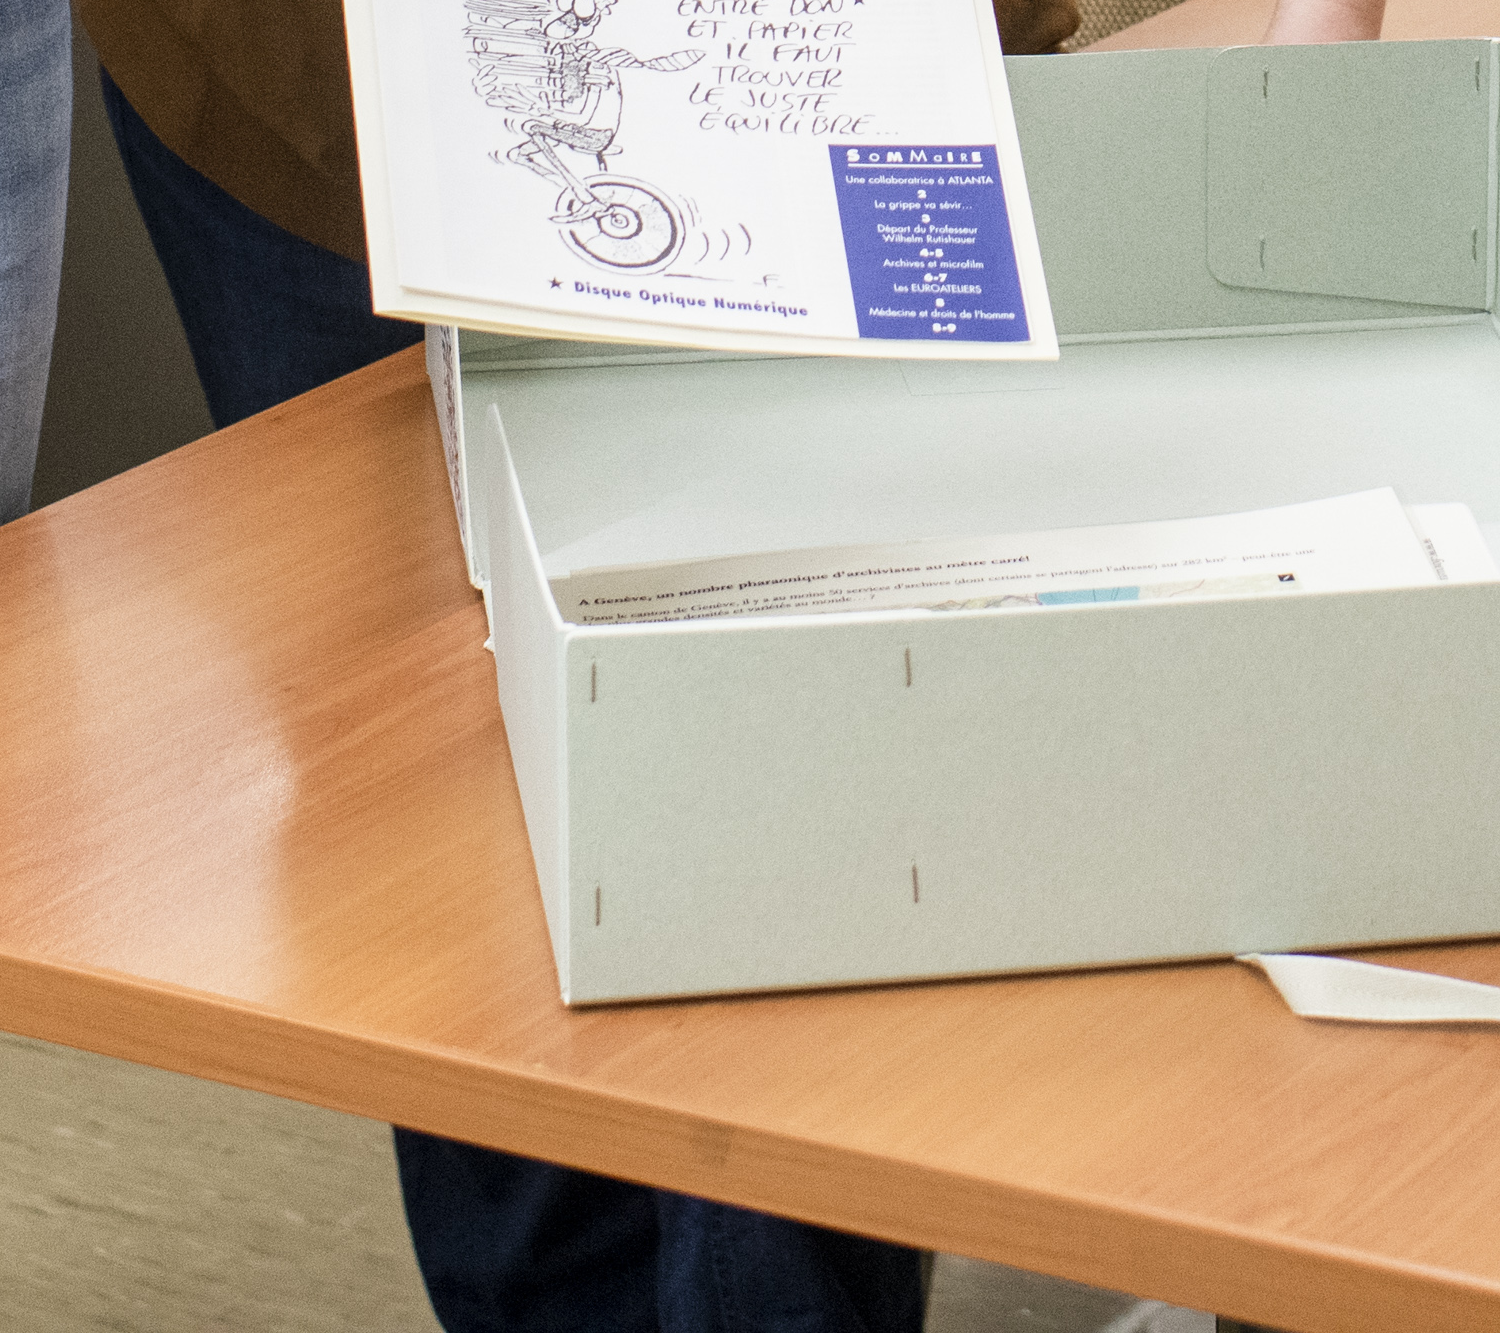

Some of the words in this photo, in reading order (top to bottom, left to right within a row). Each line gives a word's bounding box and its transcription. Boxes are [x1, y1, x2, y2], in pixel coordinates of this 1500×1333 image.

[687, 19, 727, 39] ET
[772, 42, 857, 63] FAUT
[711, 64, 843, 88] TROUVER
[689, 82, 725, 106] LE
[741, 88, 838, 113] JUSTE
[845, 175, 866, 185] Une
[868, 175, 935, 186] collaboratrice
[938, 175, 945, 185] à
[947, 175, 994, 185] ATLANTA
[917, 189, 927, 200] 2
[874, 199, 887, 209] La
[889, 201, 921, 211] grippe
[924, 201, 937, 210] va
[921, 213, 931, 224] 3
[877, 223, 911, 235] Départ
[913, 223, 927, 234] du
[929, 224, 978, 235] Professeur
[882, 234, 924, 244] Wilhelm
[883, 258, 925, 269] Archives
[928, 260, 937, 269] et
[940, 259, 984, 269] microfilm
[923, 273, 948, 283] 6-7
[894, 284, 909, 293] Les
[911, 284, 982, 295] EUROATELIERS
[574, 280, 632, 300] Disque
[638, 289, 707, 308] Optique
[713, 297, 808, 318] Numérique
[869, 307, 917, 318] Médecine
[919, 309, 928, 318] et
[931, 309, 957, 319] droits
[959, 310, 972, 319] de
[974, 310, 1015, 320] l'homme
[579, 598, 590, 606] A
[594, 595, 652, 606] Genève,
[656, 591, 675, 600] un
[679, 582, 734, 598] nombre
[739, 574, 828, 590] pharaonique
[832, 565, 921, 579] d'archivistes
[946, 559, 987, 569] mètre
[583, 614, 613, 622] Dans
[617, 612, 627, 620] le
[630, 610, 670, 618] canton
[690, 599, 740, 612] Genève,
[790, 592, 825, 600] moins
[846, 585, 891, 595] services
[894, 579, 951, 591] d'archives
[988, 571, 1032, 582] certains
[748, 603, 791, 612] variétés
